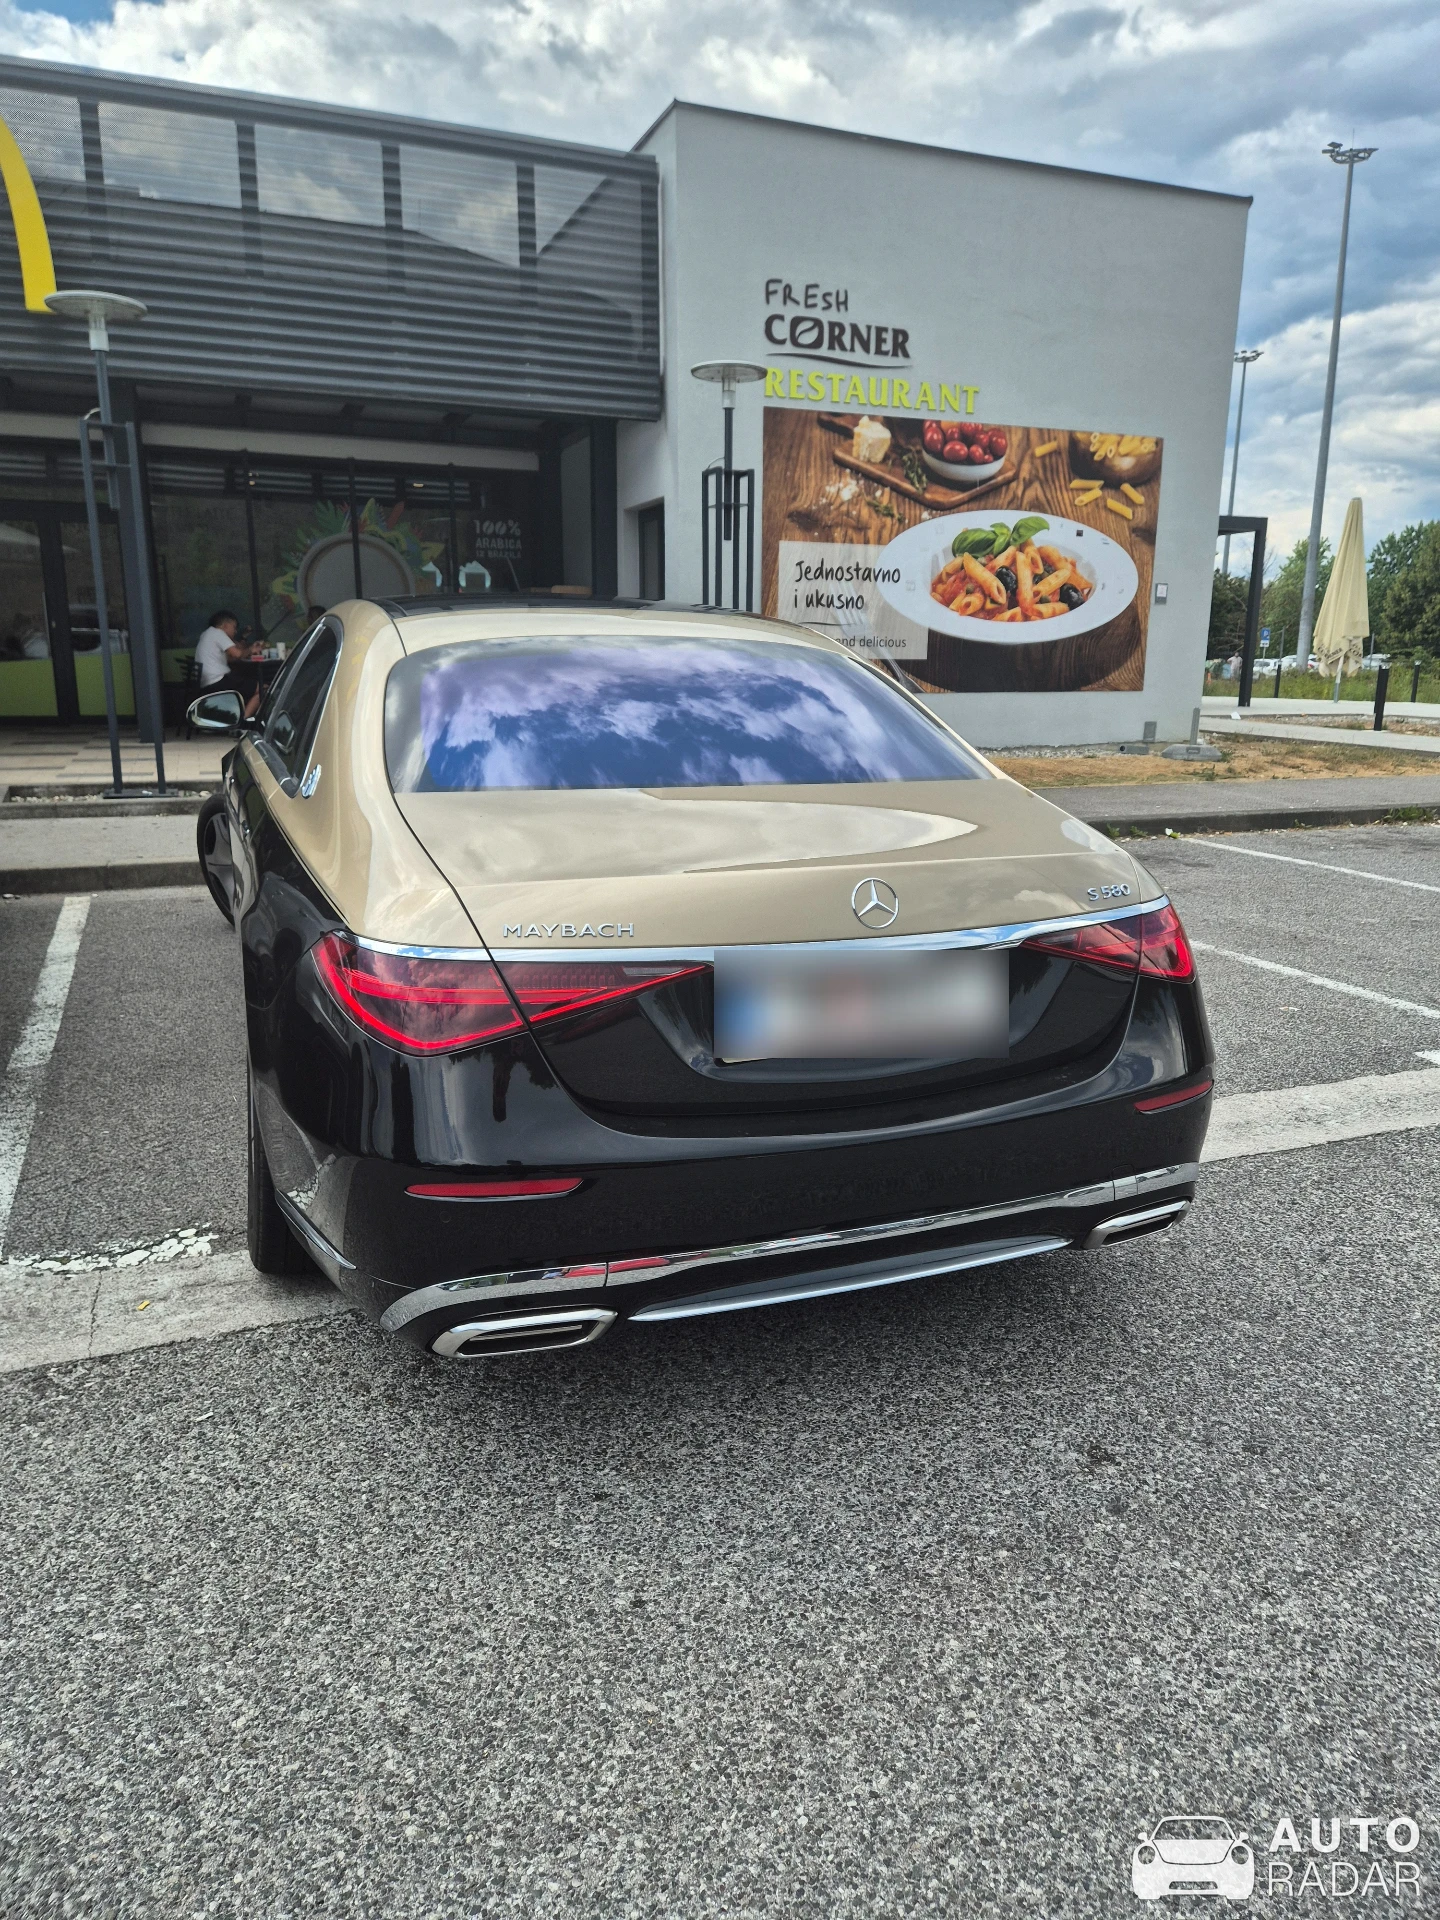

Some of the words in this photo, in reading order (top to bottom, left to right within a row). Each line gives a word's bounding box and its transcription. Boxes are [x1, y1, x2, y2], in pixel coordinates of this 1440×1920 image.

[765, 278, 849, 313] FRESH
[764, 313, 911, 358] CORNER
[764, 367, 980, 415] RESTAURANT
[473, 519, 521, 536] 100%
[475, 537, 523, 550] ARABICA
[794, 557, 901, 584] Jednostavno
[794, 588, 798, 609] i
[805, 588, 865, 610] ukusno
[859, 635, 907, 648] delicious
[1087, 886, 1100, 901] S
[1100, 883, 1131, 900] 580
[502, 922, 635, 938] MAYBACH
